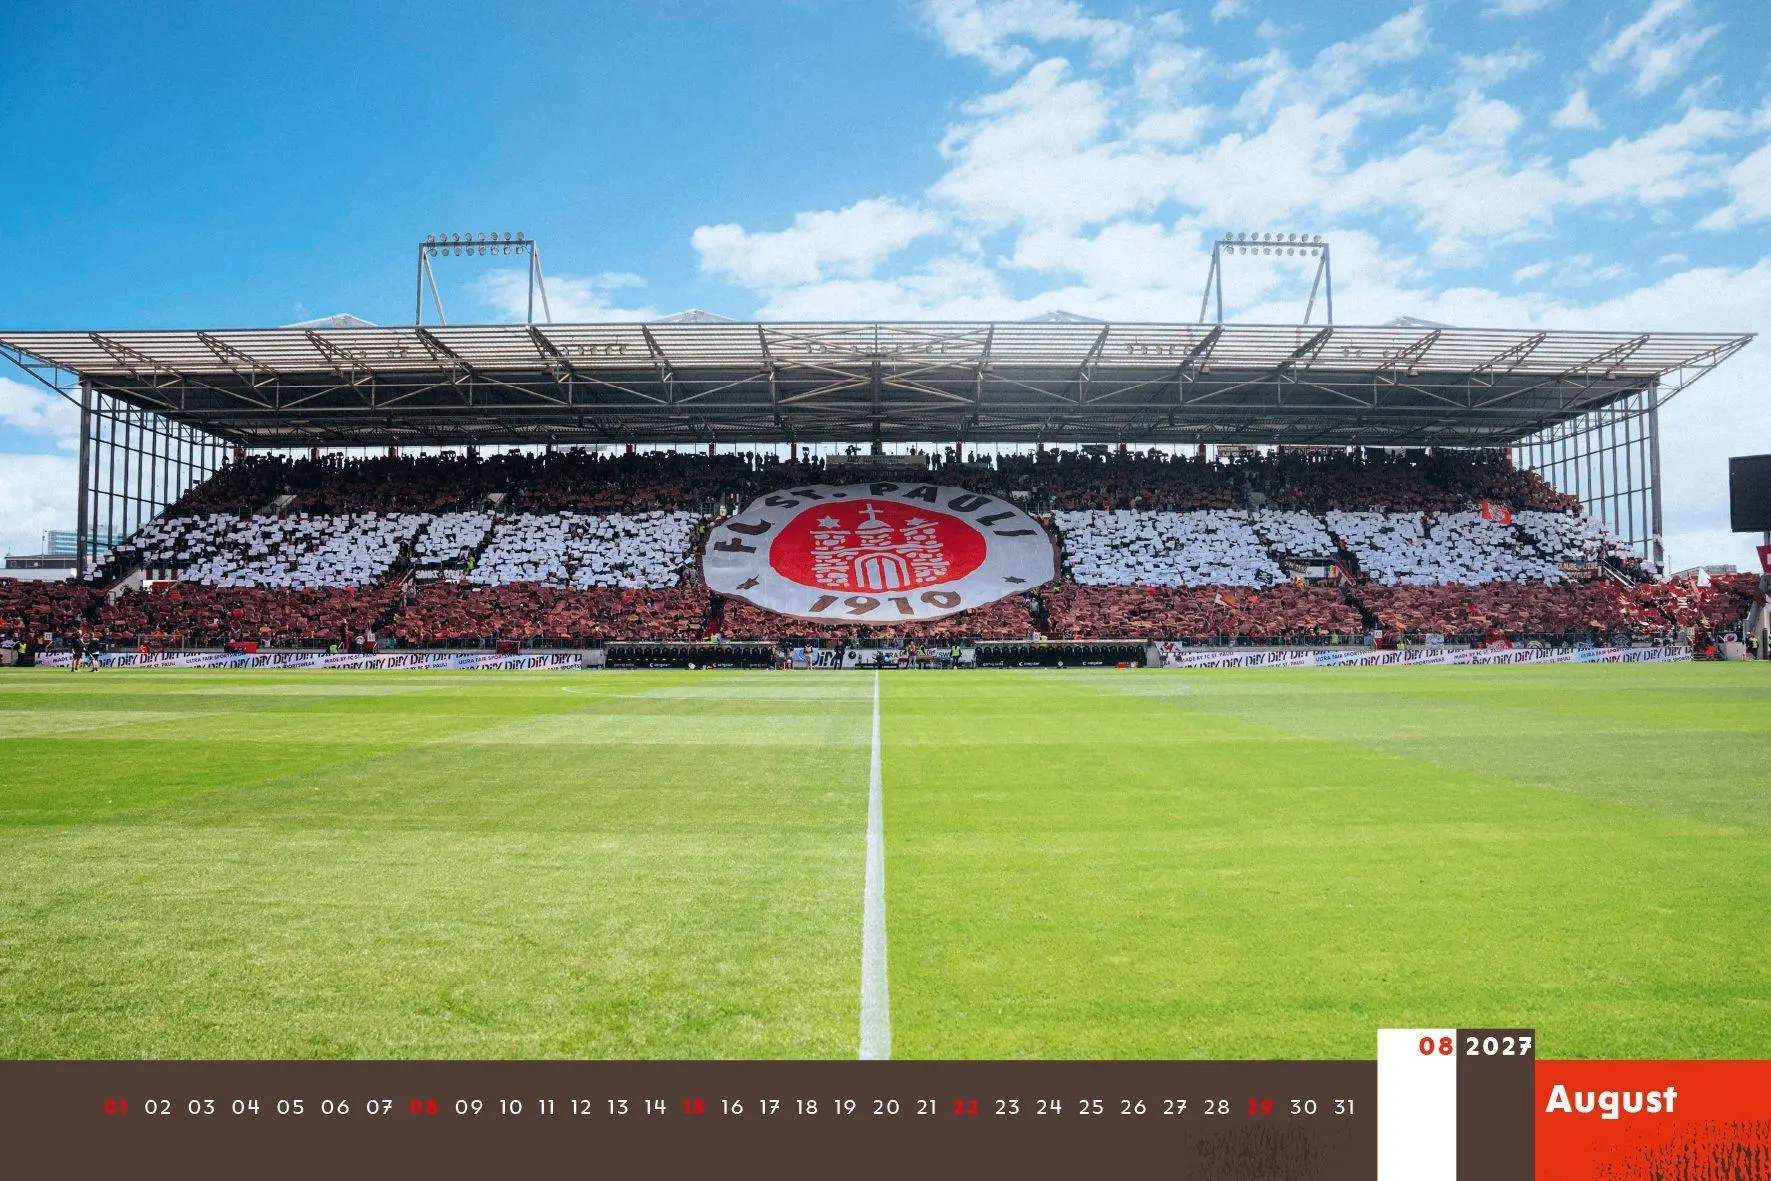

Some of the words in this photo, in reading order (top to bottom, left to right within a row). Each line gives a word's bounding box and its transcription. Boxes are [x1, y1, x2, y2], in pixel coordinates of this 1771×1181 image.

[714, 518, 772, 554] FC
[765, 489, 847, 508] ST.
[869, 483, 1038, 537] PAULI
[809, 590, 961, 615] 1910
